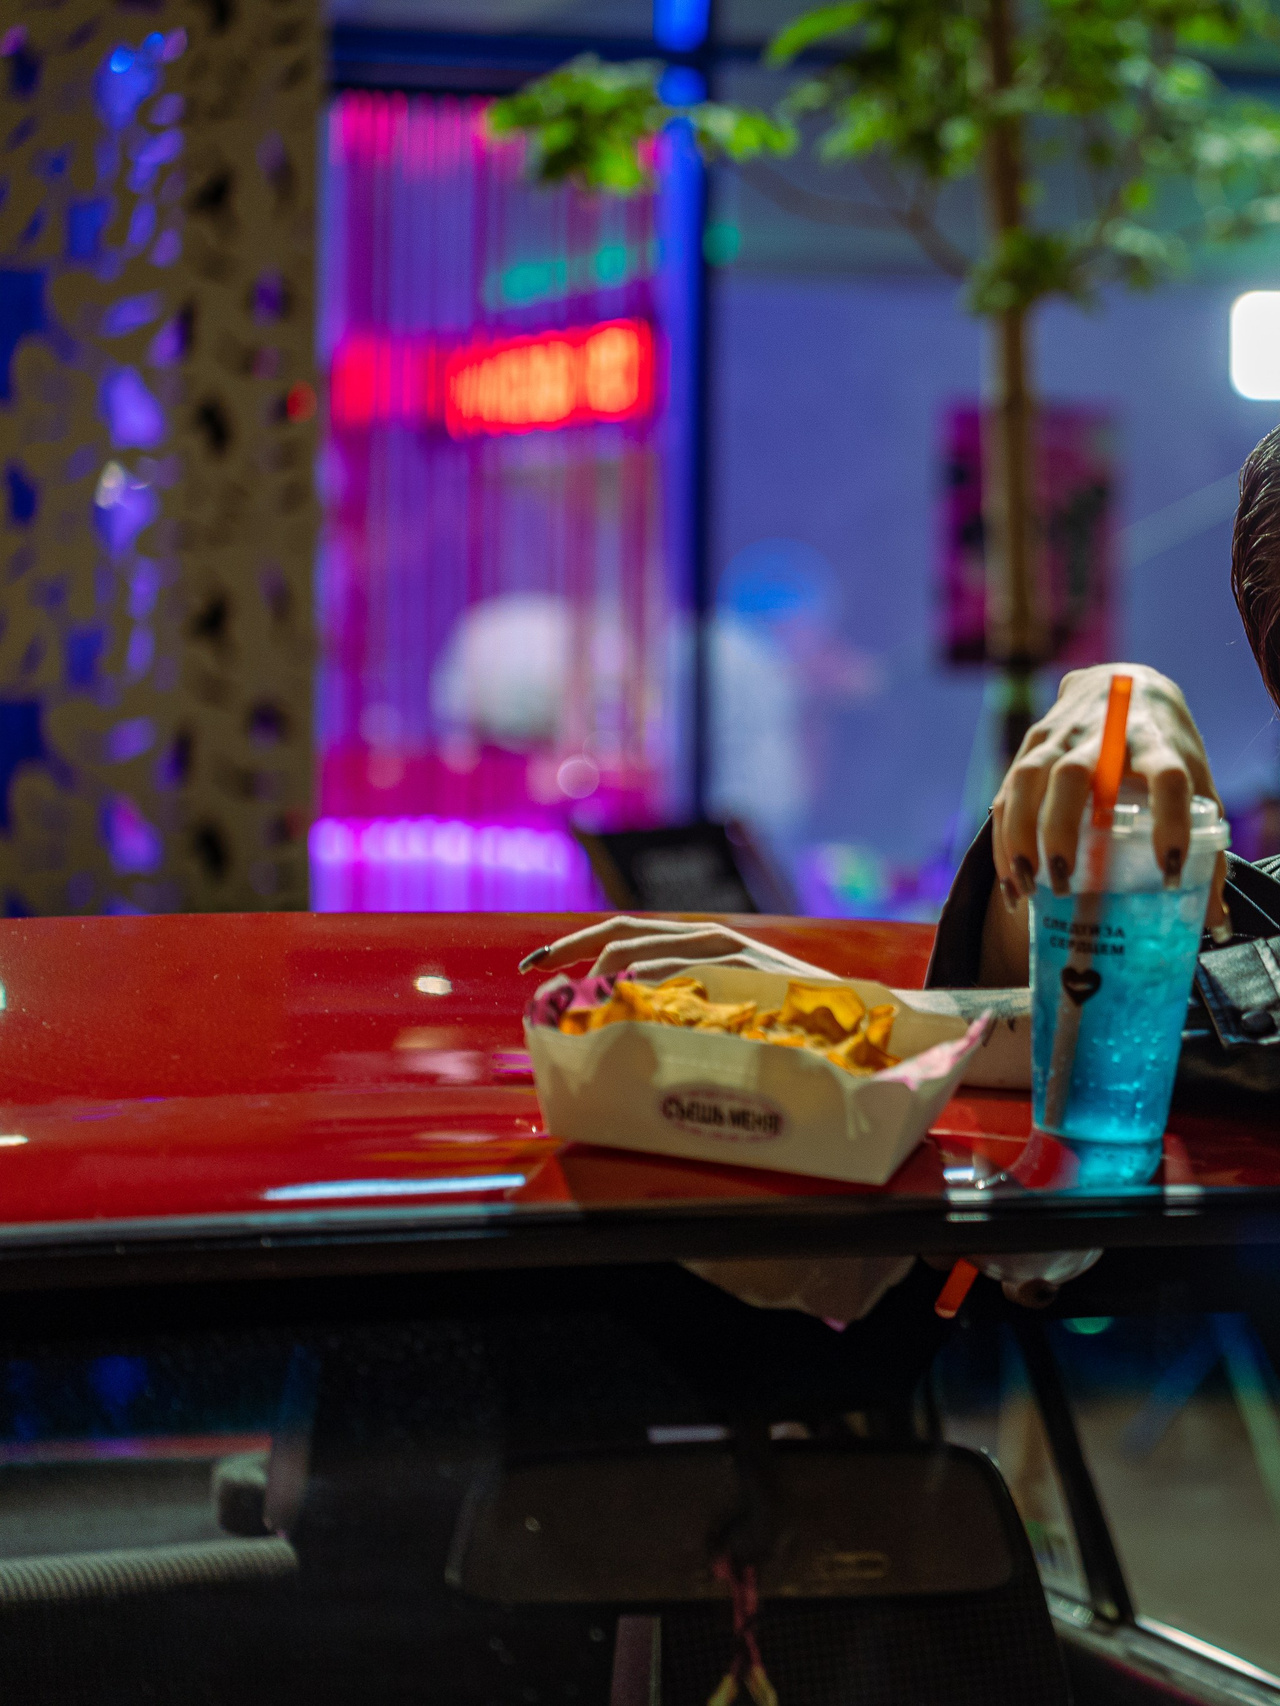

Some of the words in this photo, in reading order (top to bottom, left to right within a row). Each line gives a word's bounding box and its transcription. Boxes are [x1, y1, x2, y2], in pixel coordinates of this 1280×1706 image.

[1104, 926, 1126, 939] ЗА
[662, 1096, 725, 1126] СЪЕШЬ
[729, 1109, 781, 1136] МЕНЯ
